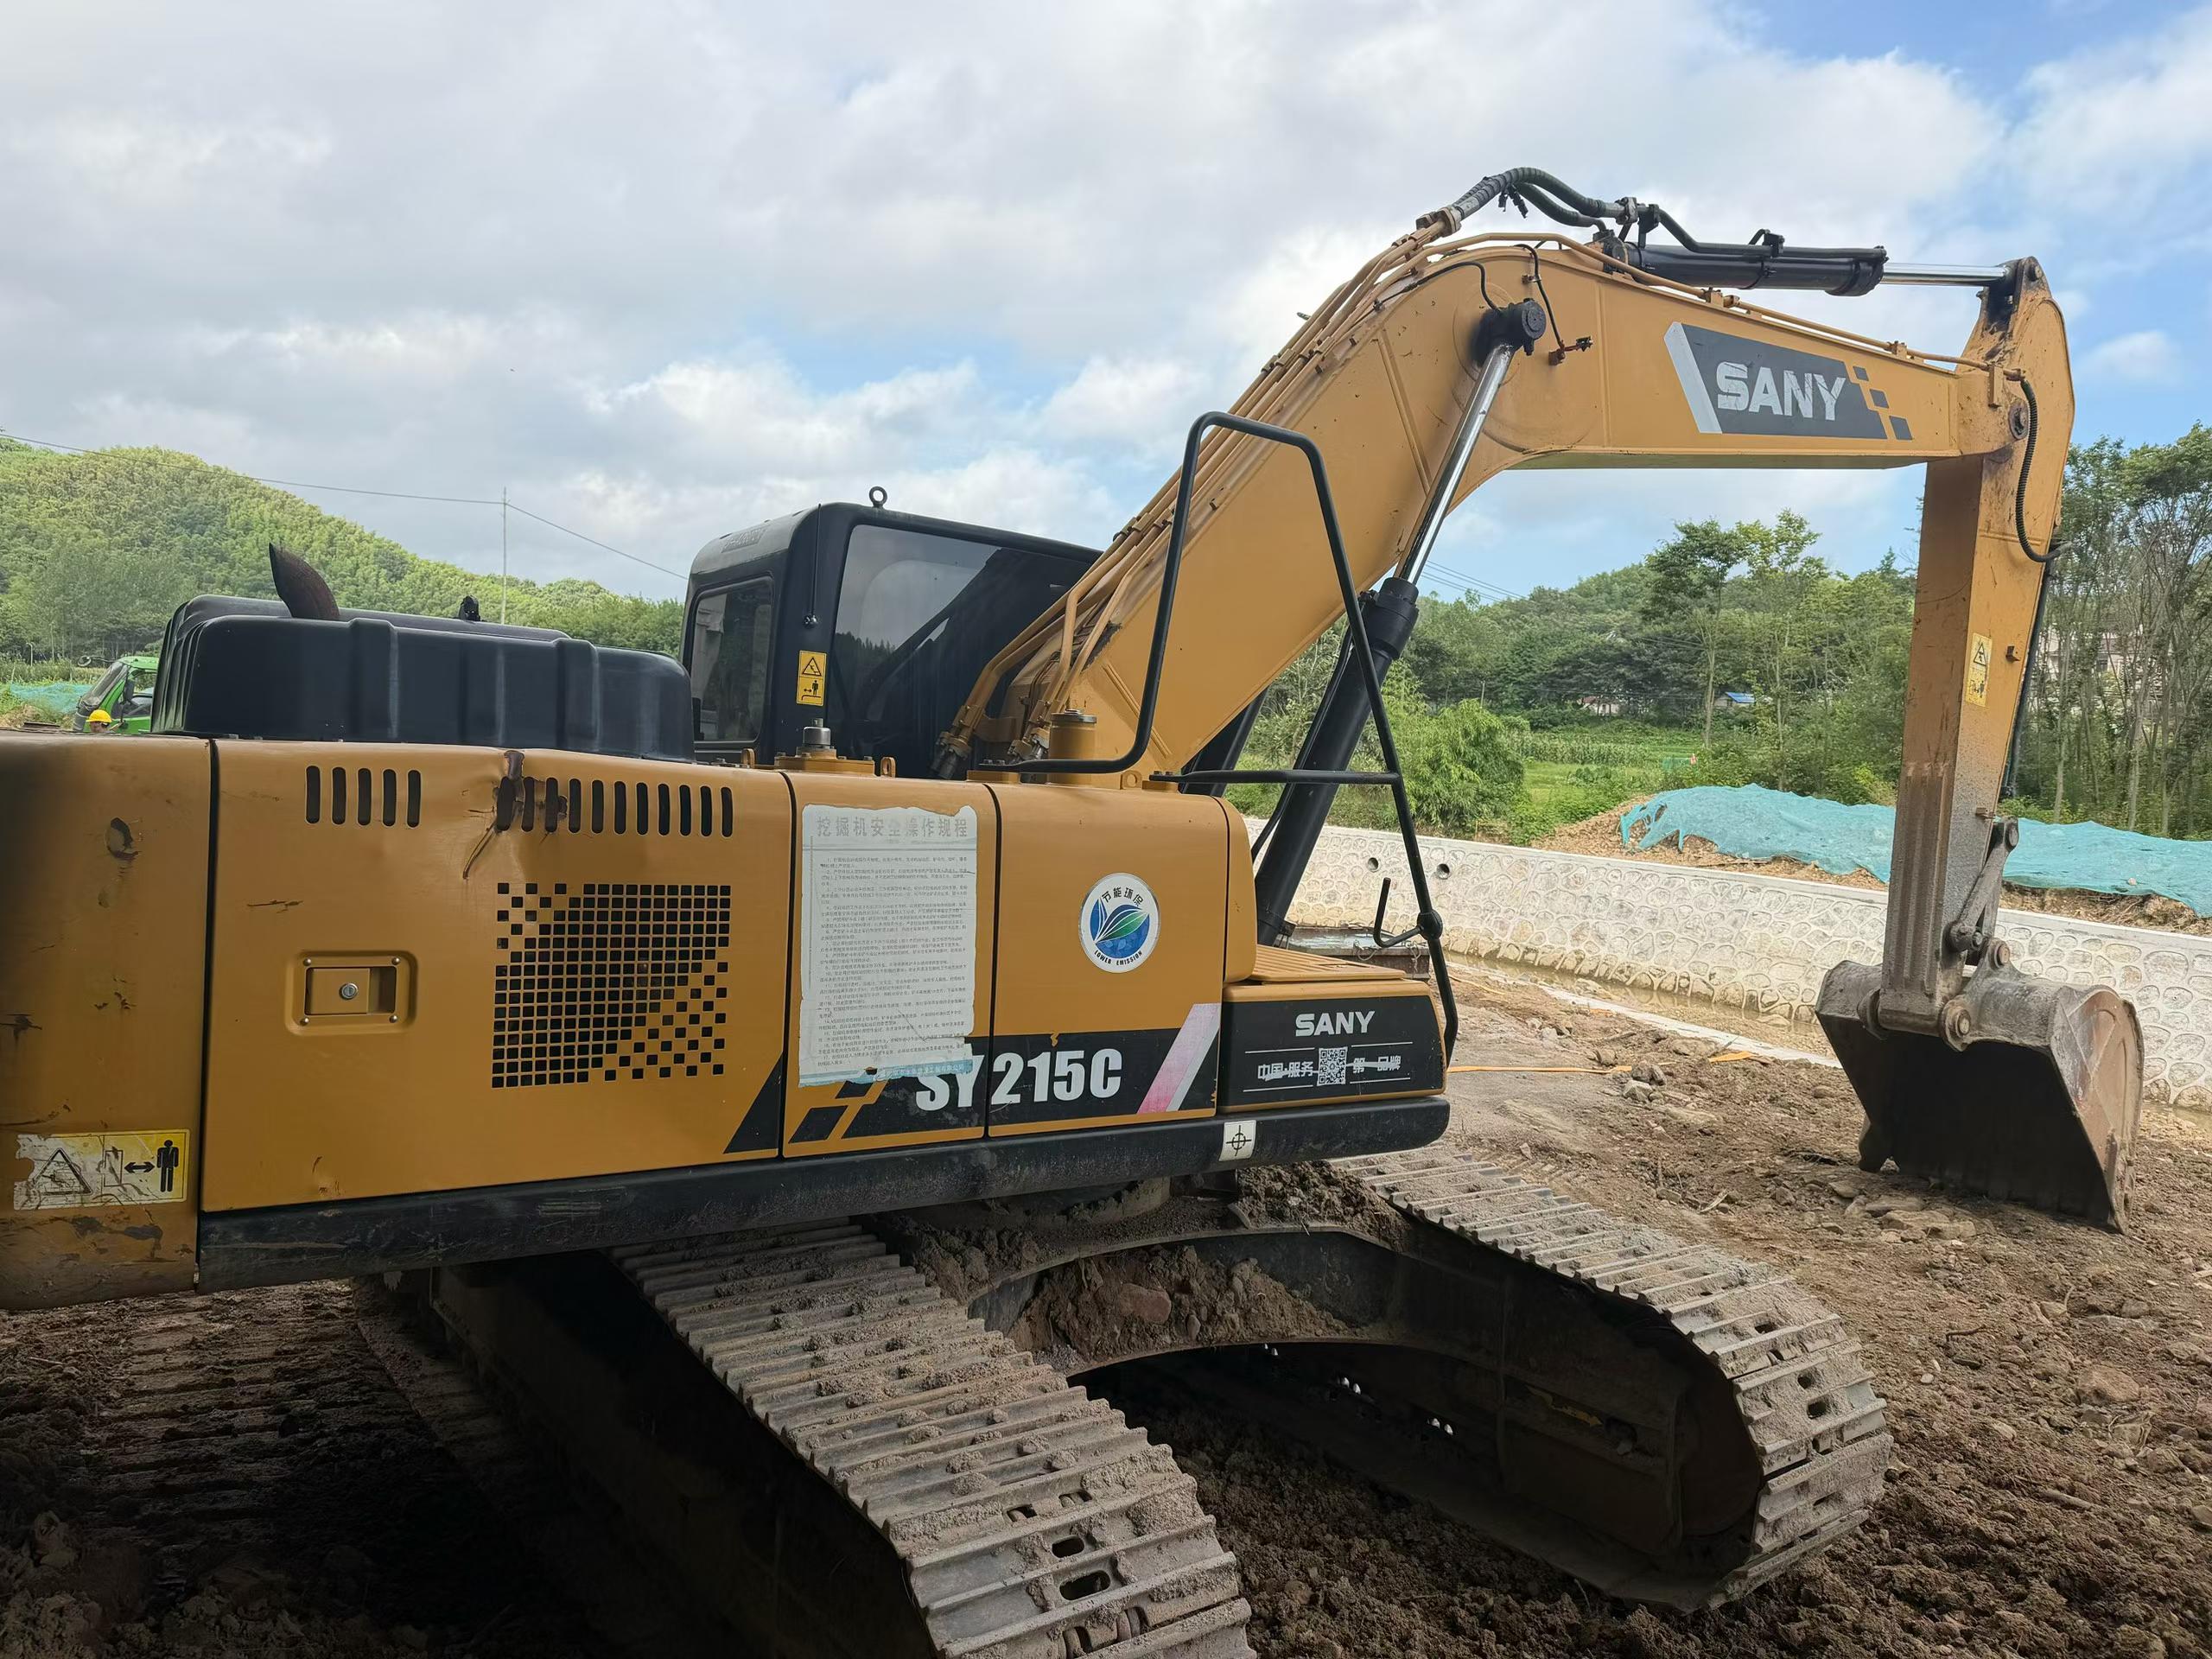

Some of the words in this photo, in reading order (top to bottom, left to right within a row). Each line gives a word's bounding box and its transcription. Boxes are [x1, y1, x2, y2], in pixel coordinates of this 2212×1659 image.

[1716, 361, 1847, 421] SANY
[1102, 887, 1143, 906] 节能环保
[1295, 1010, 1376, 1037] SANY
